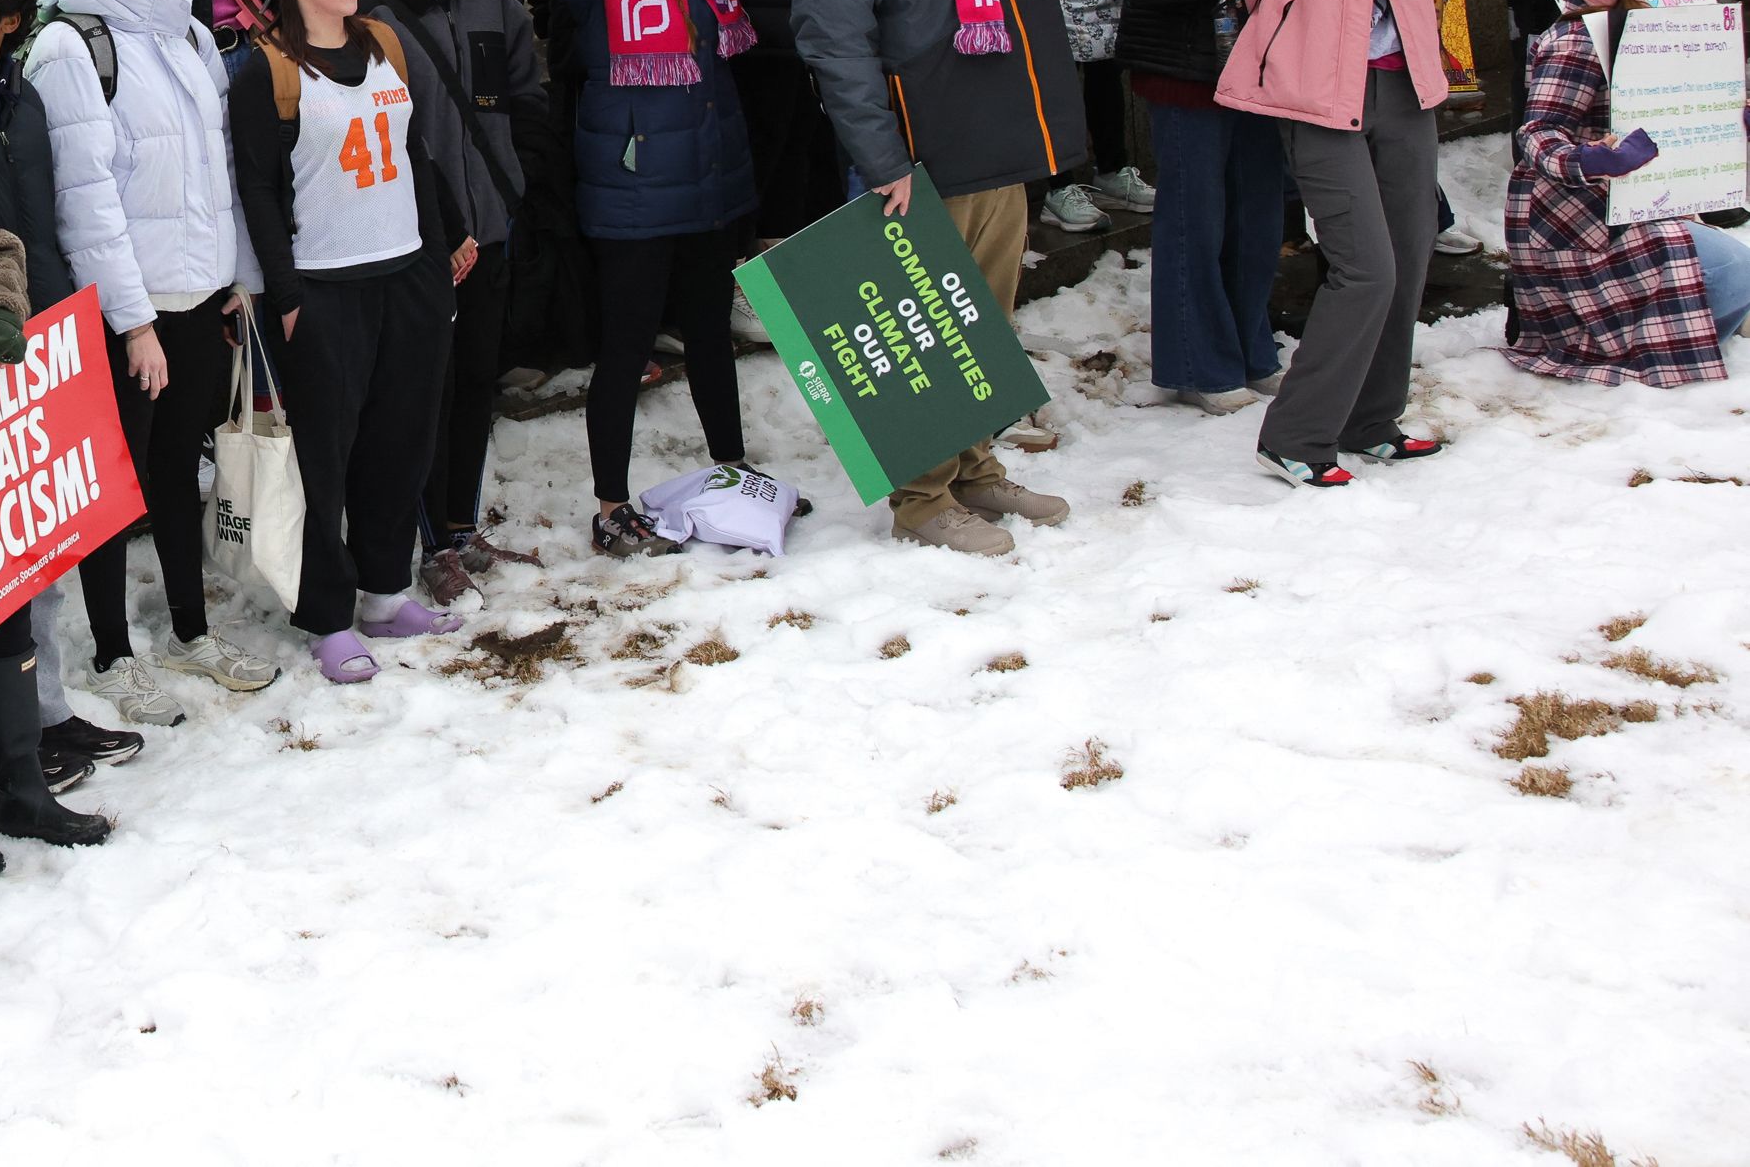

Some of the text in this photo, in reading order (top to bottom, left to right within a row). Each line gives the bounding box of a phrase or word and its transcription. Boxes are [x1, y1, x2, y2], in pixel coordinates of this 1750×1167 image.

[372, 87, 409, 106] PRIME
[337, 111, 398, 190] 41
[883, 221, 992, 402] COMMUNITIES
[897, 298, 935, 353] OUR
[941, 271, 979, 327] OUR
[822, 322, 878, 399] FIGHT
[853, 323, 892, 378] OUR
[858, 281, 932, 395] CLIMATE
[804, 380, 821, 401] CLUB
[812, 375, 832, 406] SIERRA
[48, 549, 56, 560] OF
[57, 531, 80, 556] AMERICA
